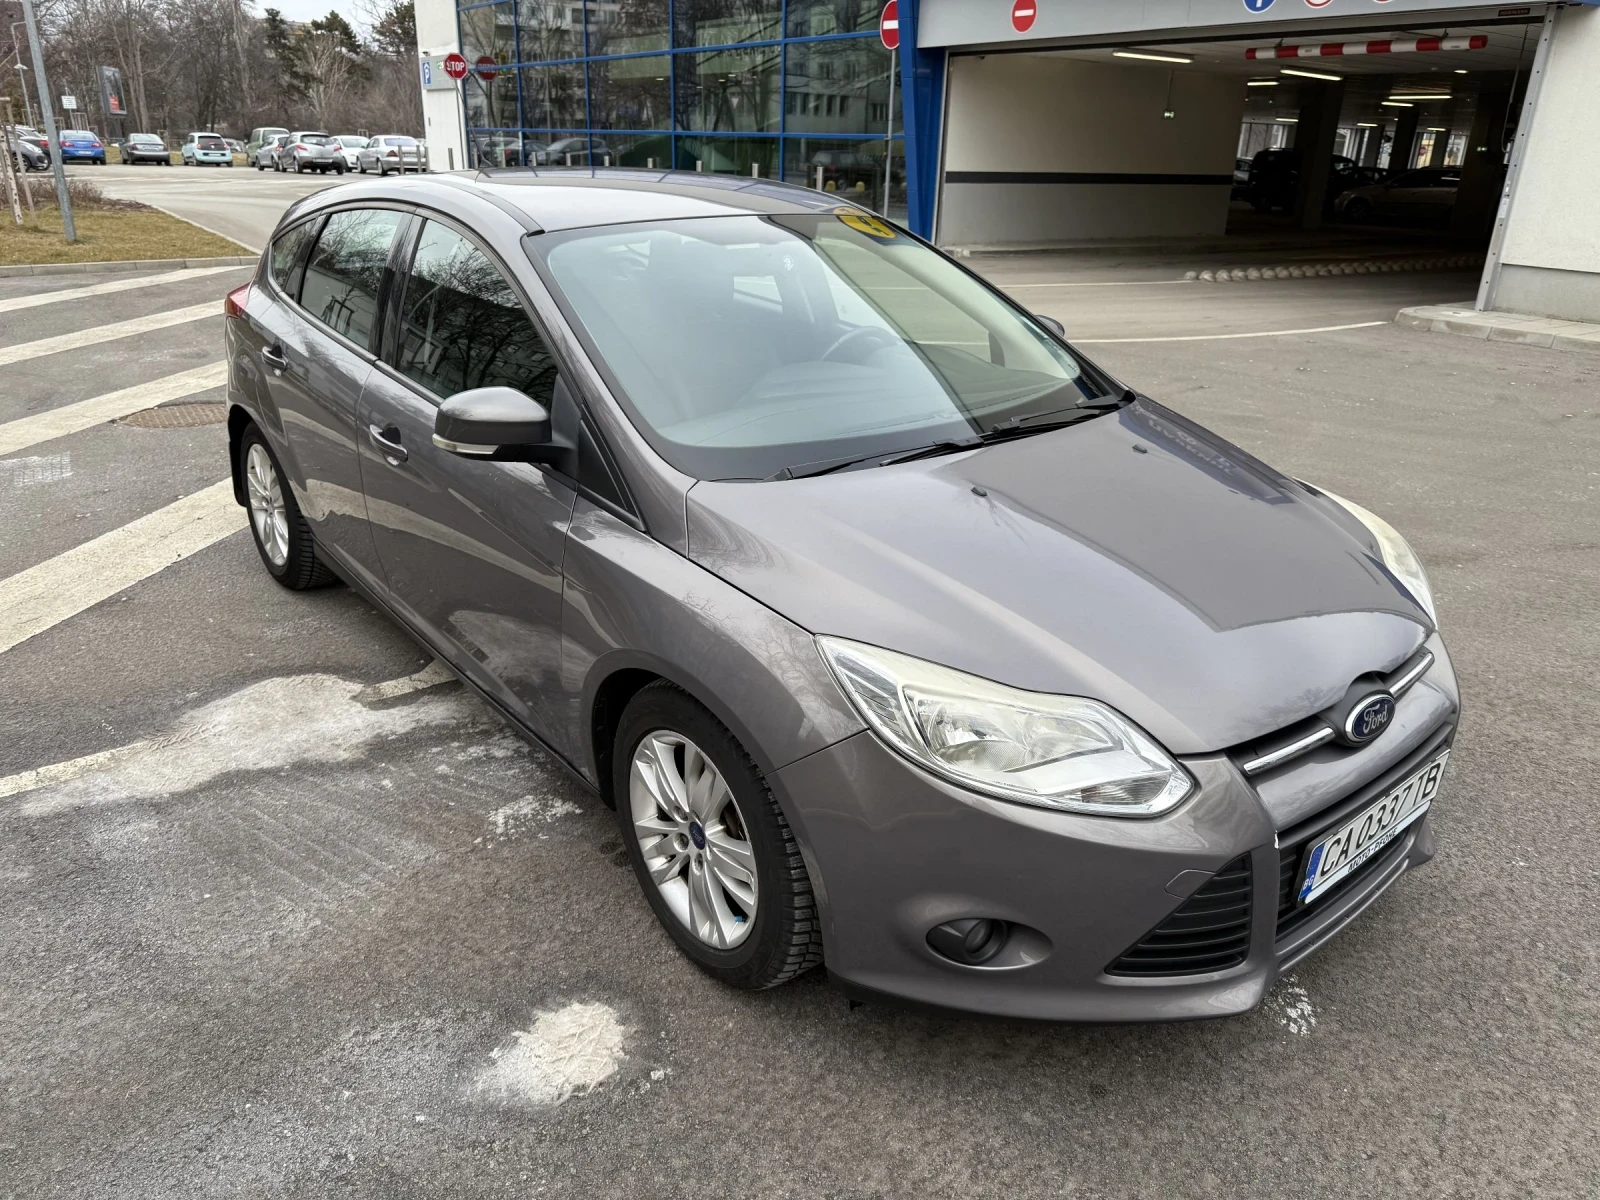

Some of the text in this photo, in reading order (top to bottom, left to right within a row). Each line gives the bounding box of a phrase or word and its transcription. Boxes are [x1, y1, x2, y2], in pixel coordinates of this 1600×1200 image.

[446, 61, 465, 72] STOP
[1363, 703, 1388, 734] Ford
[1320, 762, 1441, 877] CA 0337 TB
[1302, 874, 1315, 891] BG
